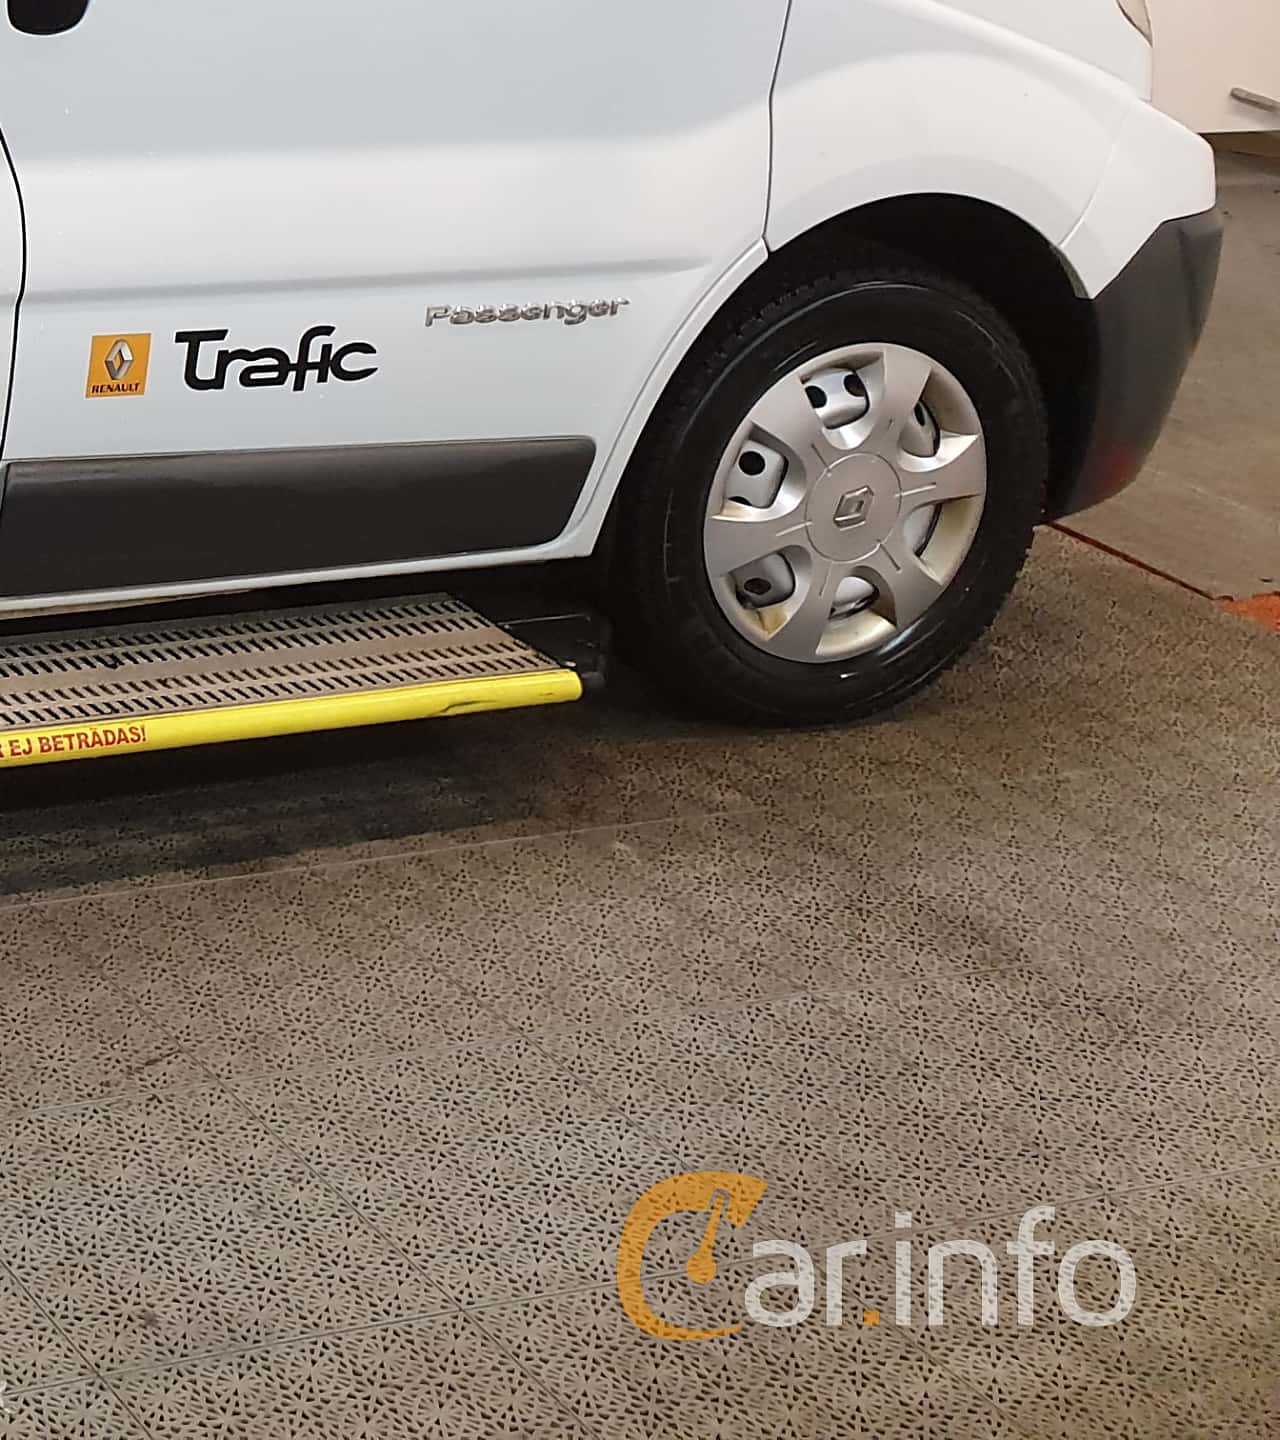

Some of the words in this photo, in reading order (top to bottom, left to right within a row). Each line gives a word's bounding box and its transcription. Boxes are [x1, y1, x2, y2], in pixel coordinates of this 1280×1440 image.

[424, 296, 630, 327] Passenger
[174, 325, 379, 392] Trafic
[90, 382, 141, 394] RENAULT
[8, 738, 33, 757] EJ
